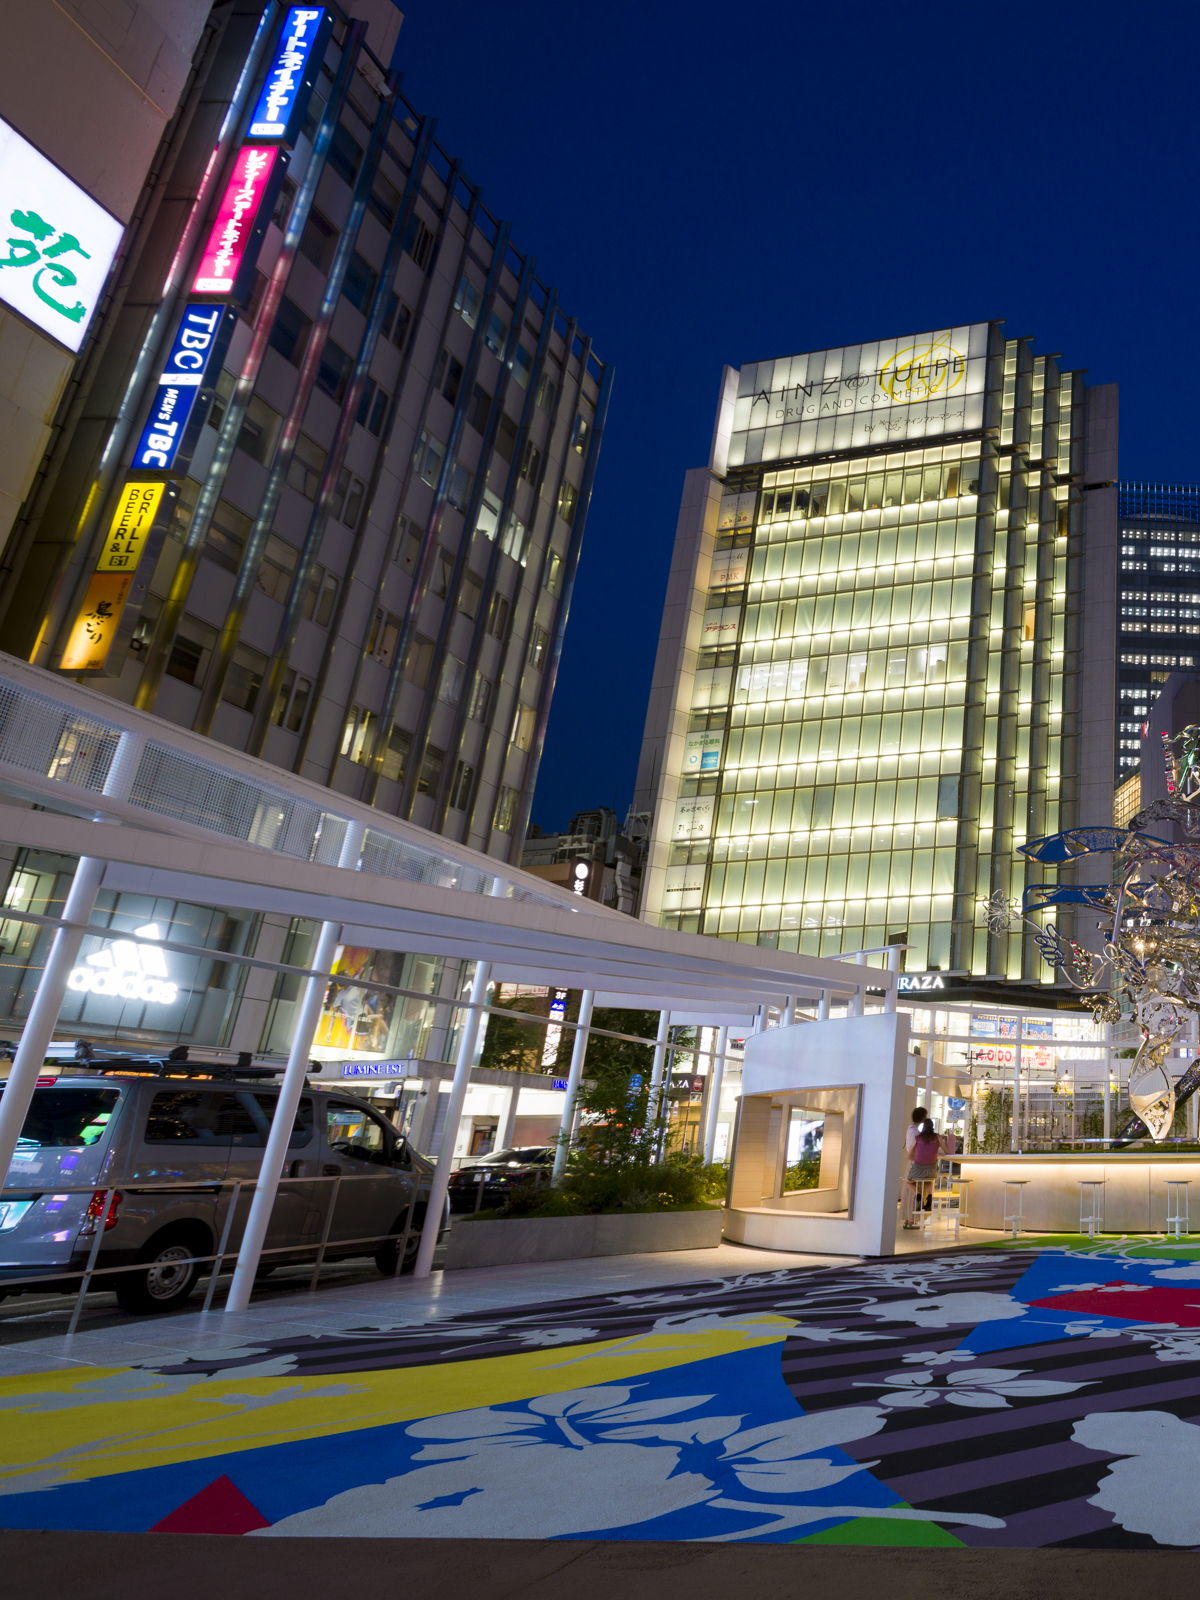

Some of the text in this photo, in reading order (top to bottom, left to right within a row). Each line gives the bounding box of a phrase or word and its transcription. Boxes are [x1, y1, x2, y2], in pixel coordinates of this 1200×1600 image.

[266, 10, 319, 121] アートネイチャー
[213, 149, 268, 277] レディースアートネイチャー
[174, 310, 219, 370] TBC
[752, 376, 839, 407] AINZ
[874, 354, 966, 386] TULPE
[775, 384, 939, 419] DRUG AND COSMETIC
[141, 388, 179, 468] MEN'S TBC
[864, 423, 876, 433] by
[903, 410, 964, 427] アインファーマシーズ
[110, 488, 141, 553] BEER &
[124, 488, 155, 554] GRILL
[110, 555, 128, 567] B1
[720, 572, 739, 582] PMK
[704, 623, 736, 633] アデランス
[66, 966, 178, 1004] adidas
[343, 1063, 404, 1076] LUMINE EST
